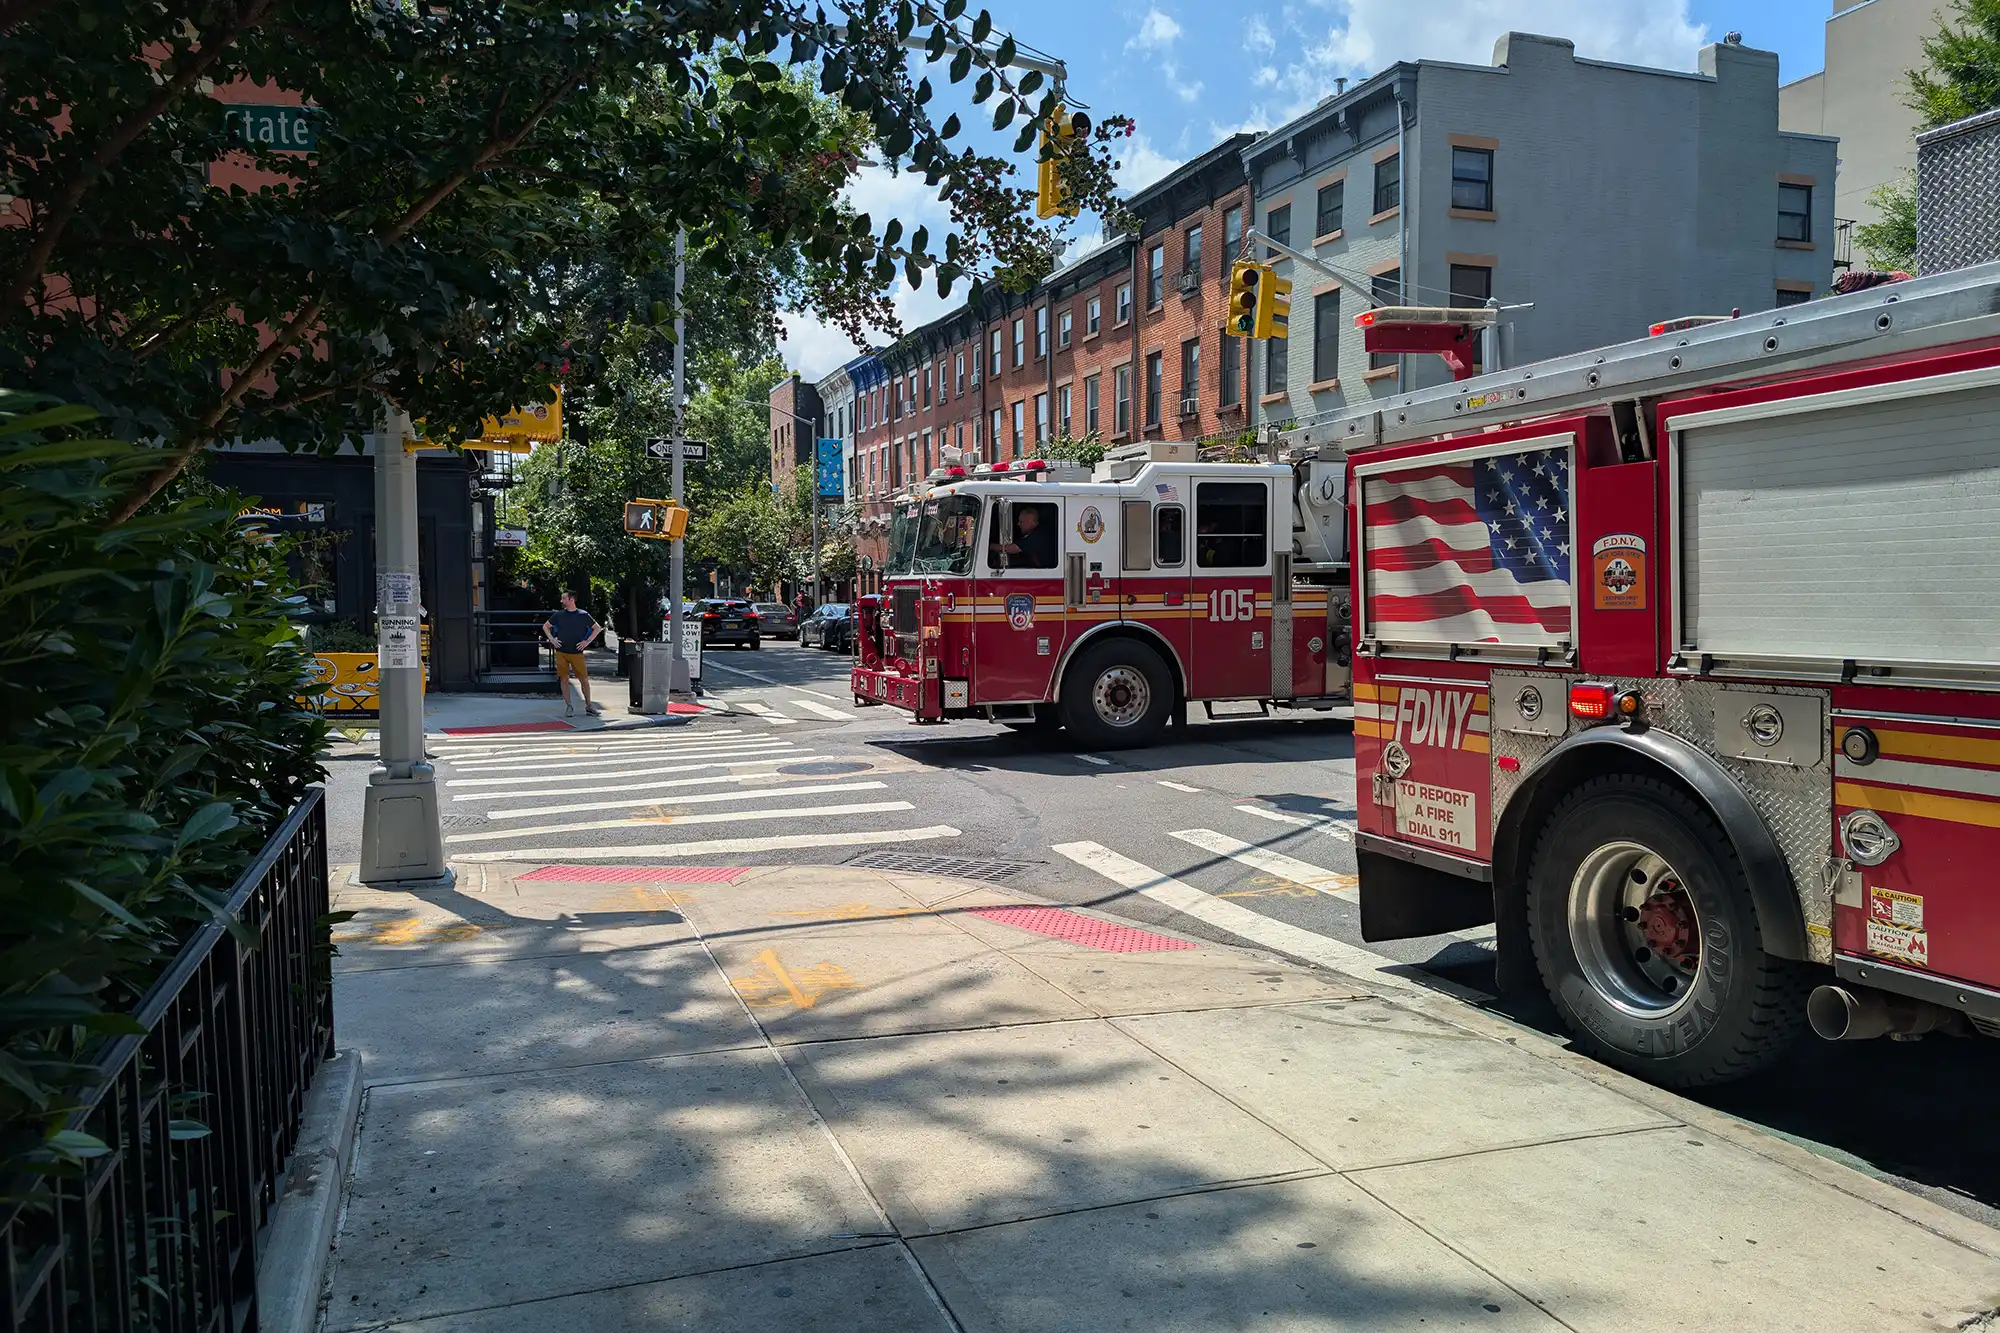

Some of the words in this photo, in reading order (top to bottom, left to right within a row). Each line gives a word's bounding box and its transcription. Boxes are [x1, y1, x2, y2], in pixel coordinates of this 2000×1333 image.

[1209, 589, 1254, 622] 105
[874, 676, 887, 698] 105
[1395, 687, 1474, 750] FDNY
[1400, 782, 1416, 797] TO
[1419, 786, 1469, 808] REPORT
[1414, 804, 1424, 818] A
[1427, 806, 1455, 824] FIRE
[1408, 820, 1436, 839] DIAL
[1439, 828, 1461, 845] 911
[1885, 892, 1917, 903] CAUTION
[1870, 940, 1907, 952] EXHAUST
[1873, 932, 1905, 945] HOT
